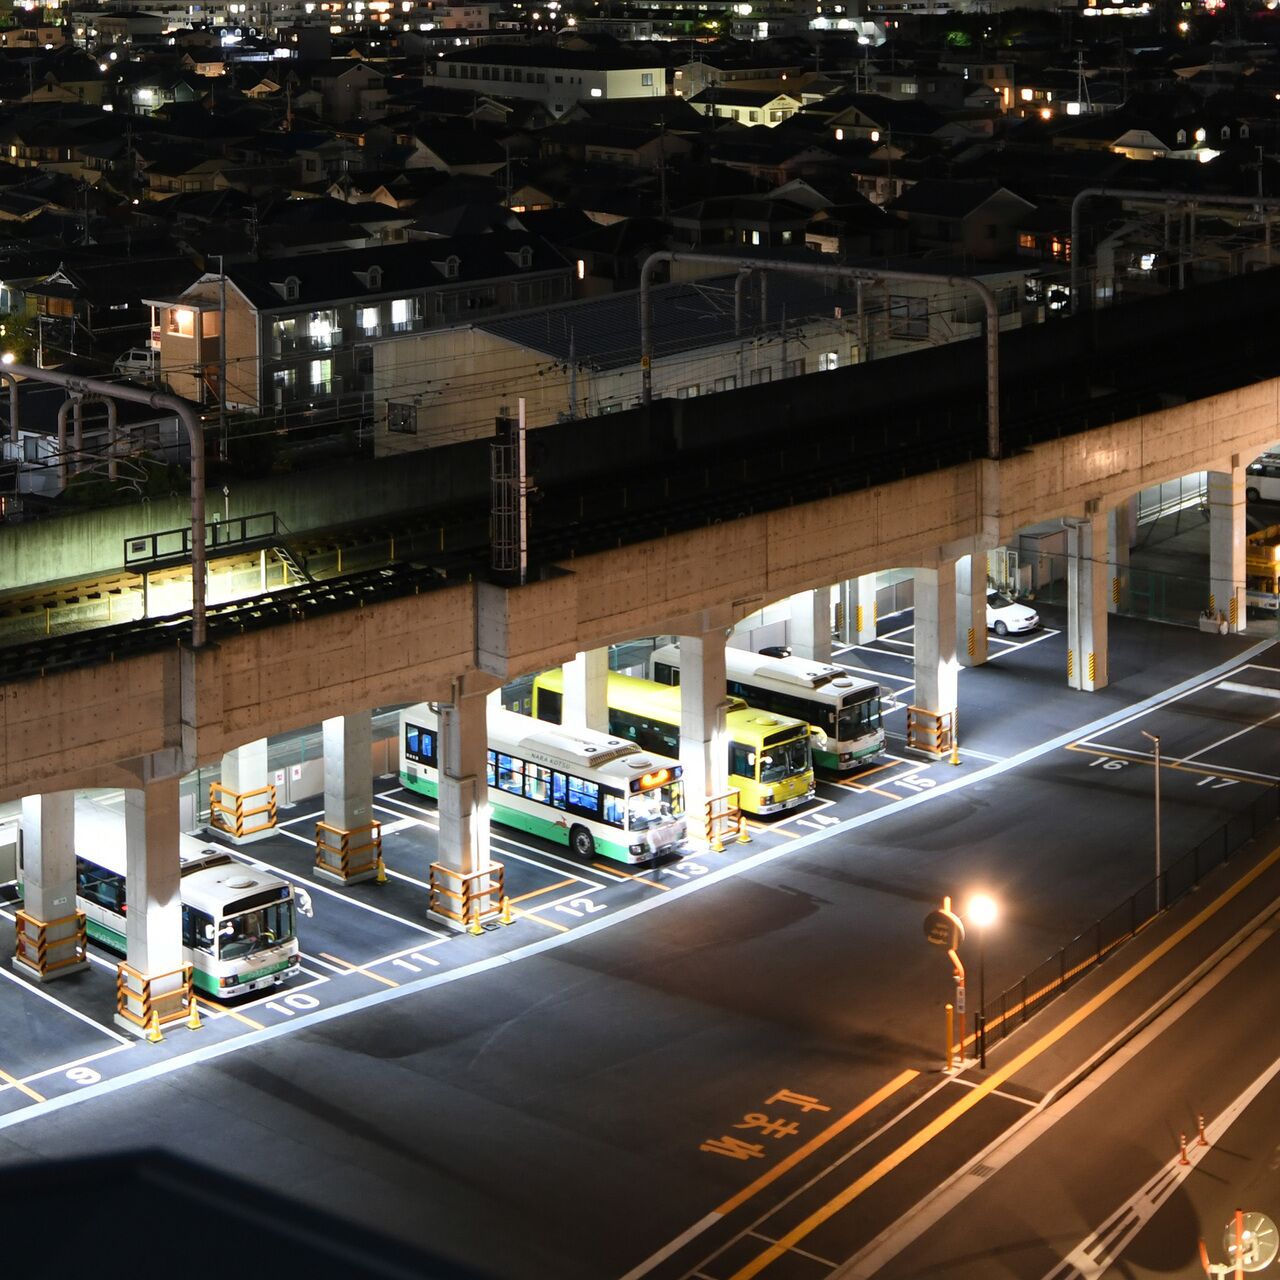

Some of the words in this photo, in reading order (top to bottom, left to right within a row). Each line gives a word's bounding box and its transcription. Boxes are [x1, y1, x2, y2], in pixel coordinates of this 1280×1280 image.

[1089, 756, 1129, 771] 16
[894, 774, 937, 792] 15
[1196, 775, 1240, 789] 17
[797, 813, 841, 830] 14
[662, 861, 709, 881] 13
[554, 898, 606, 918] 12
[391, 952, 440, 973] 11
[265, 993, 320, 1016] 10
[65, 1067, 101, 1085] 9
[699, 1088, 832, 1160] 止まれ
